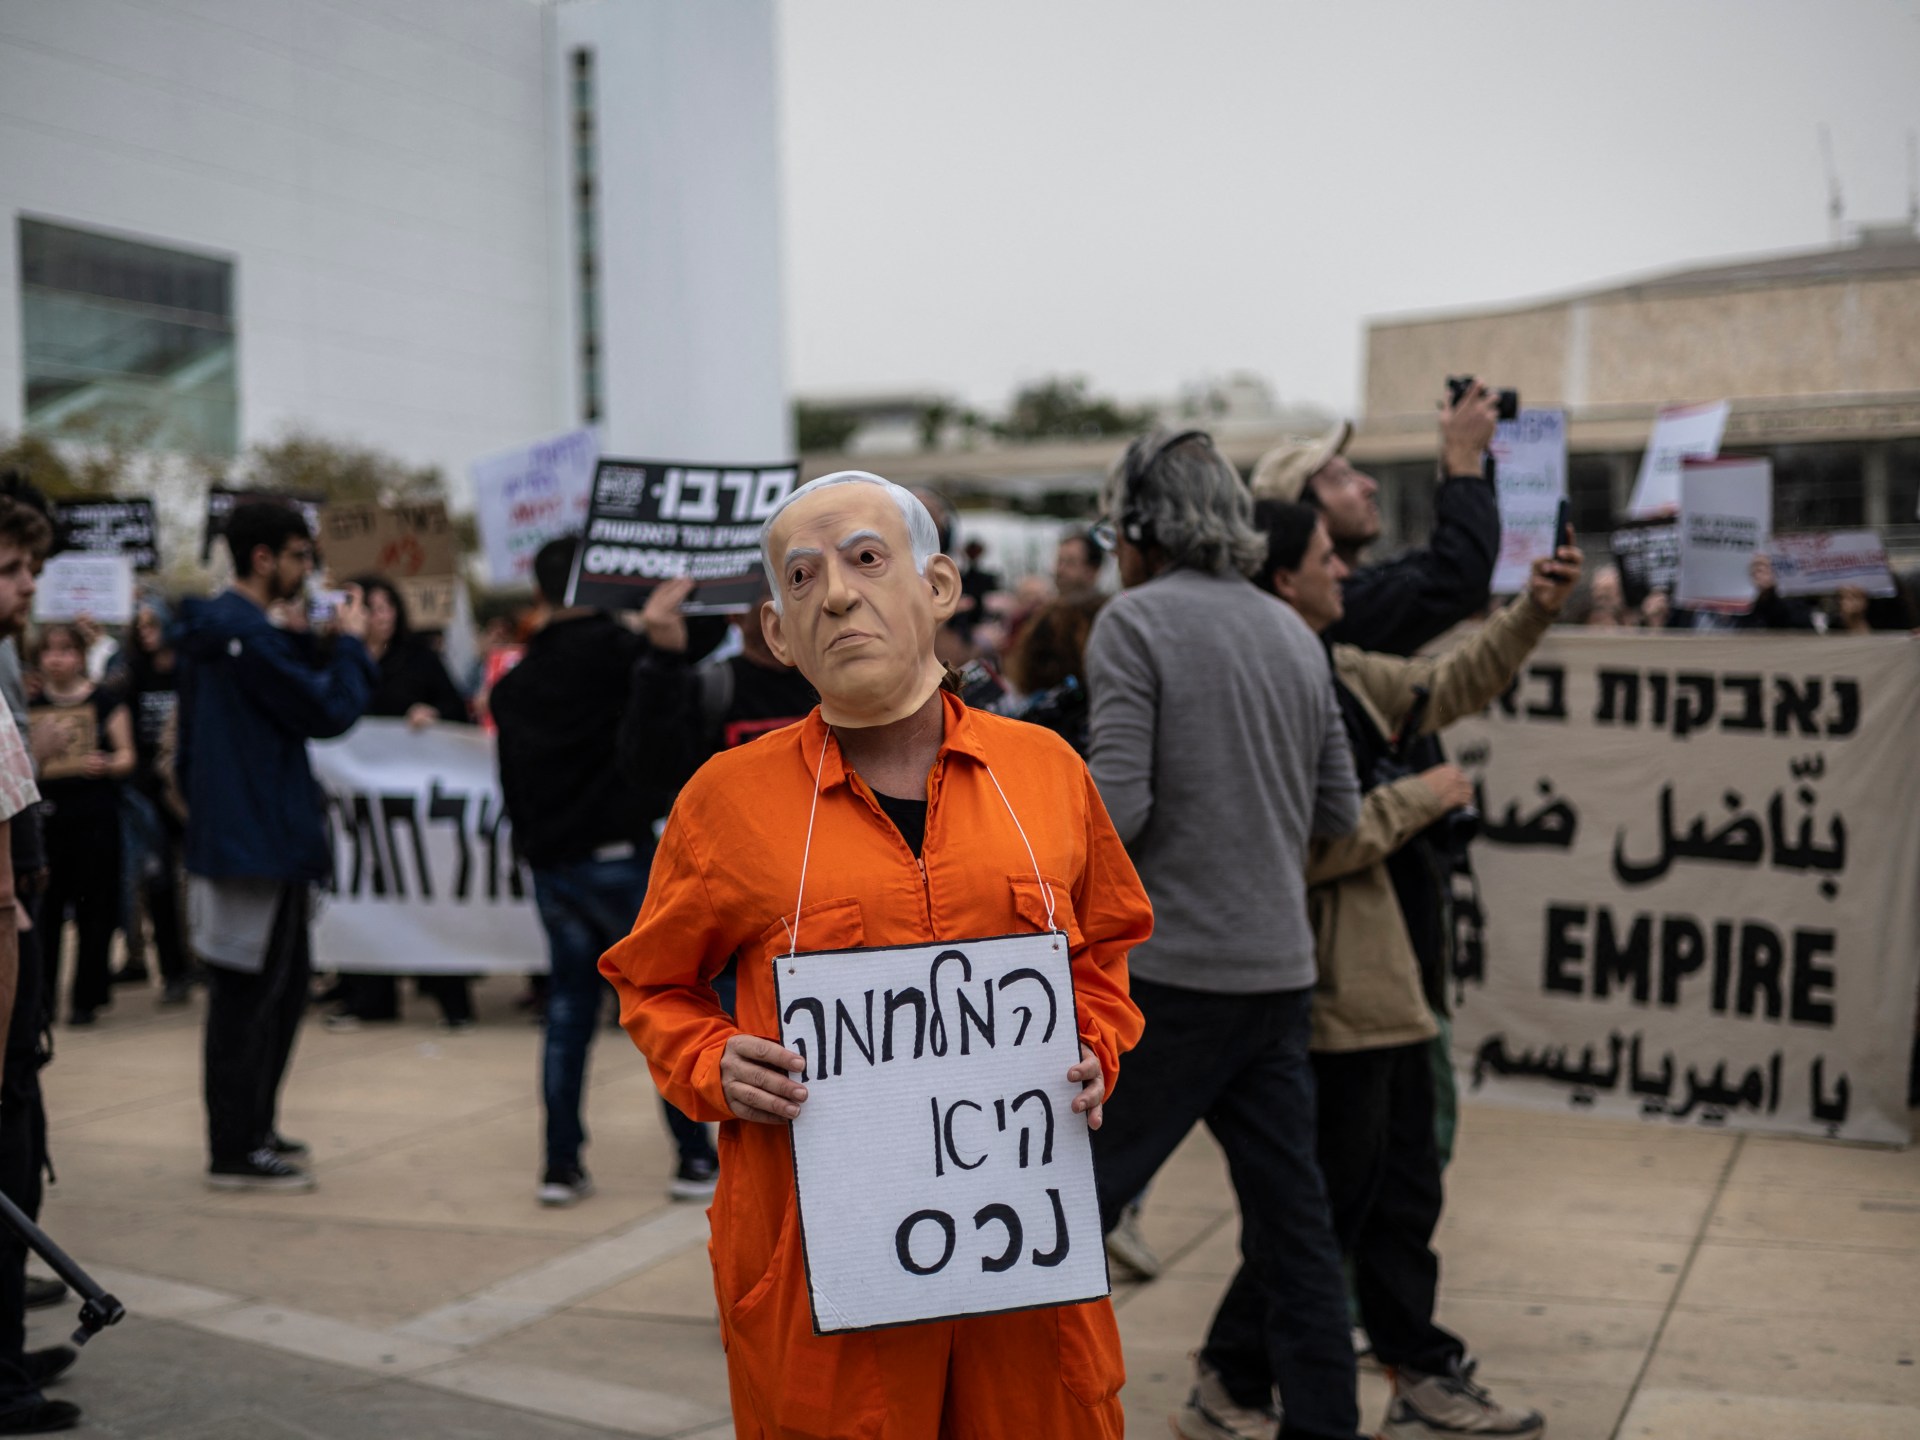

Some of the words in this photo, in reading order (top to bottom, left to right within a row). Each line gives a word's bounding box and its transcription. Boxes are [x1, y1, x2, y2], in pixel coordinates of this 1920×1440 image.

[583, 544, 689, 579] OPPOSE
[1595, 664, 1862, 741] נאבקות
[1542, 902, 1837, 1028] EMPIRE
[783, 950, 1057, 1083] המלחמה
[931, 1088, 1055, 1178] היא
[895, 1188, 1070, 1276] נכס
